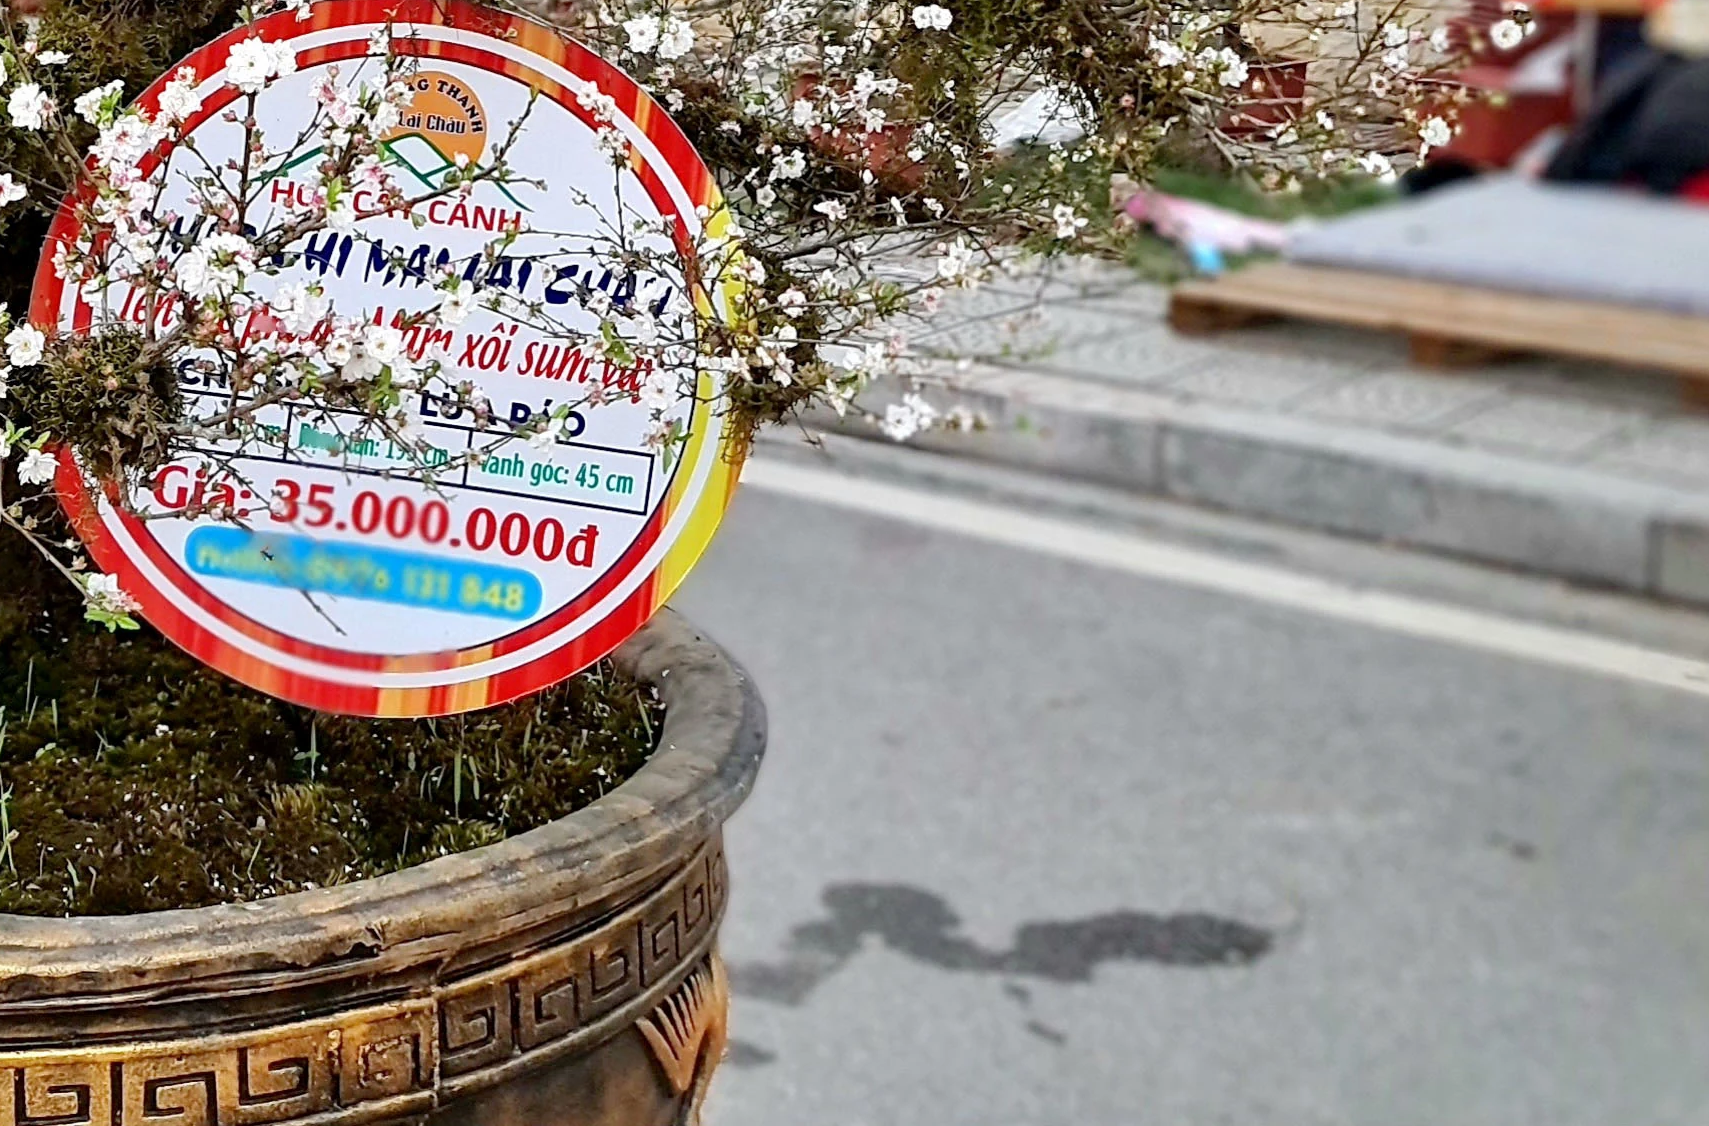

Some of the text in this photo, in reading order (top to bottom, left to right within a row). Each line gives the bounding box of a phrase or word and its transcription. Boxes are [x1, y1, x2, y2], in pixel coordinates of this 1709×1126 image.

[398, 110, 421, 128] Lai
[436, 79, 484, 133] THANH
[428, 194, 522, 232] CẢNH
[457, 322, 519, 372] xôi
[517, 340, 592, 384] sum
[575, 462, 600, 489] 45
[605, 473, 634, 495] cm
[153, 464, 252, 519] Giá:
[269, 478, 600, 568] 35.000.000đ
